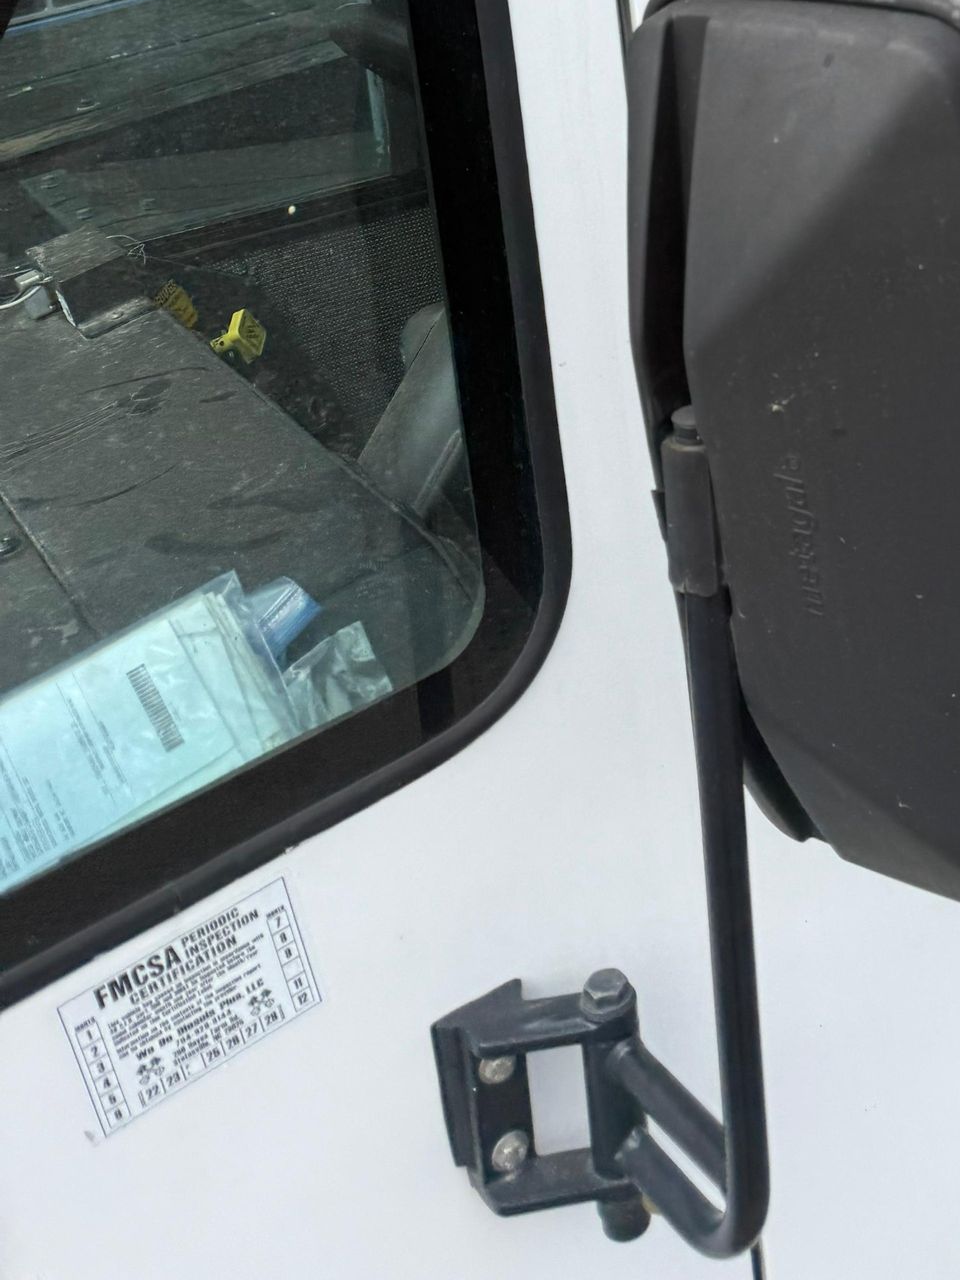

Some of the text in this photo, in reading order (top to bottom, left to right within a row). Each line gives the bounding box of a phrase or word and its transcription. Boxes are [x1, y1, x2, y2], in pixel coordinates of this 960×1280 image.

[180, 907, 240, 949] PERIODIC
[184, 908, 259, 960] INSPECTION
[93, 945, 182, 1010] FMCSA
[129, 934, 238, 1006] CERTIFICATION
[293, 976, 303, 990] 11
[297, 991, 308, 1006] 12
[145, 1083, 161, 1101] 22
[166, 1070, 181, 1087] 23
[244, 1021, 258, 1039] 27
